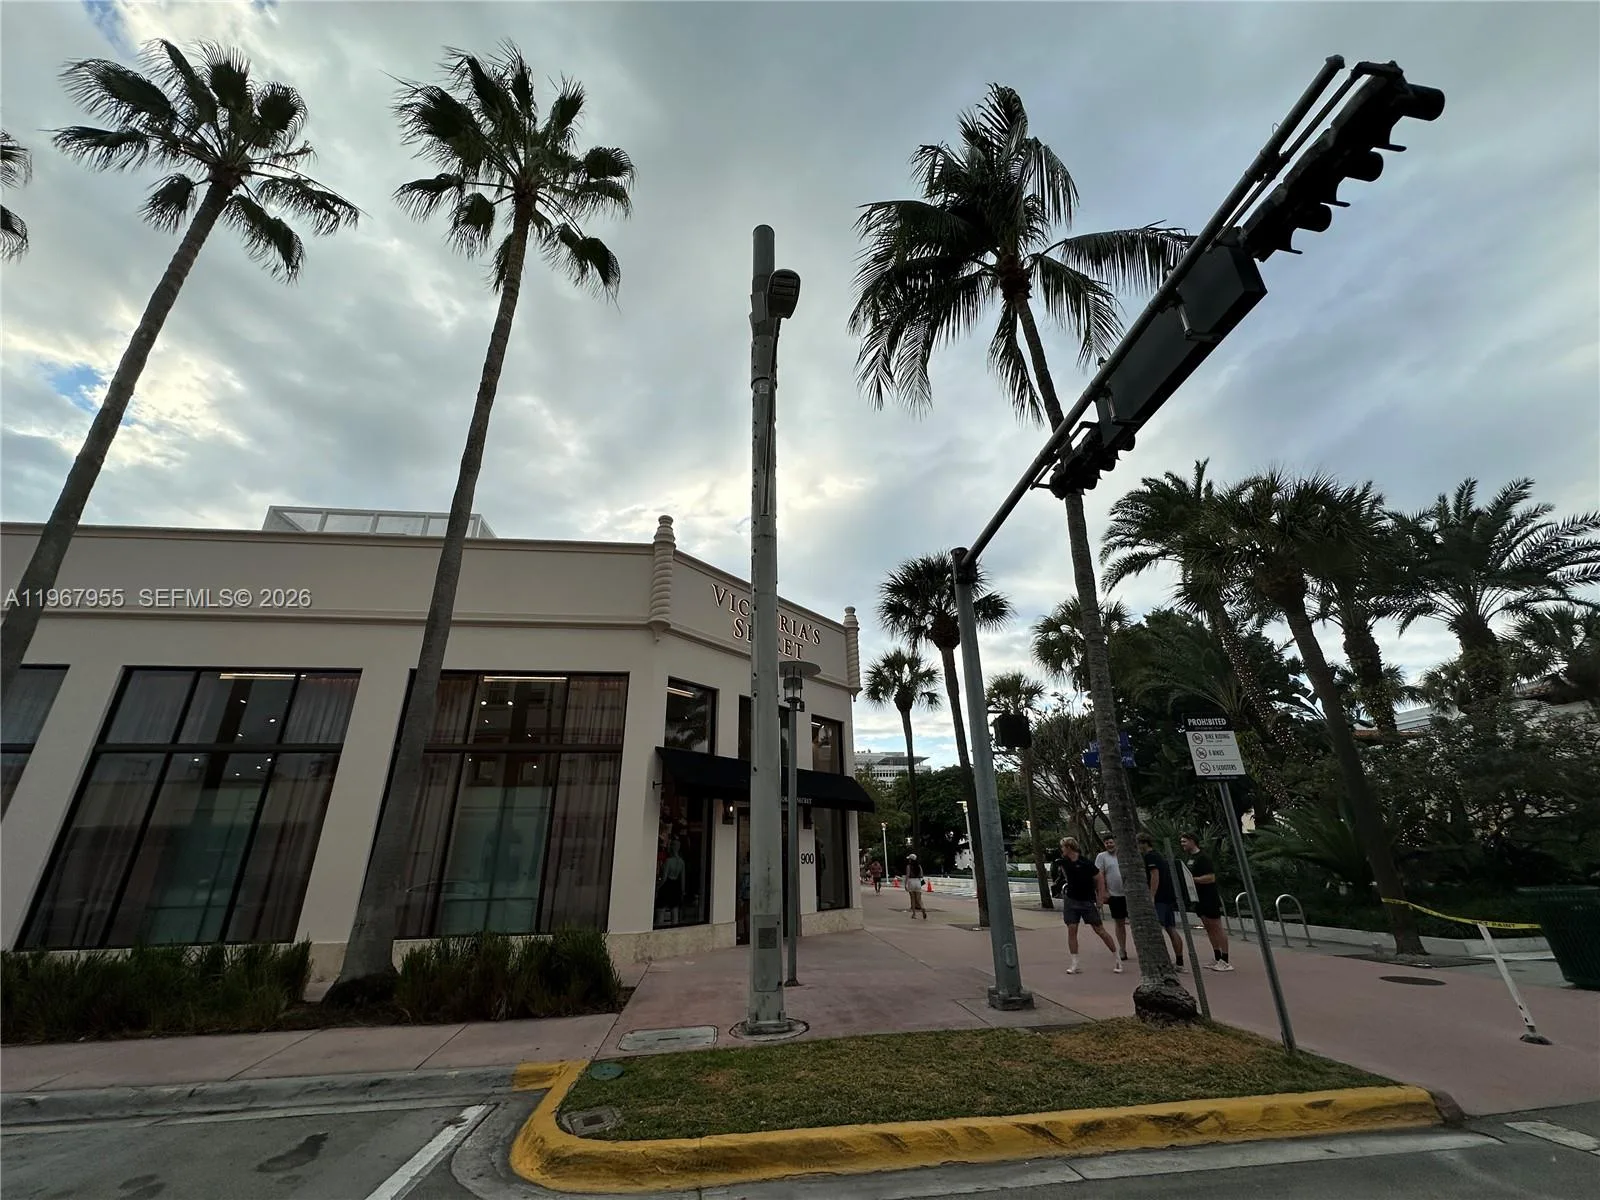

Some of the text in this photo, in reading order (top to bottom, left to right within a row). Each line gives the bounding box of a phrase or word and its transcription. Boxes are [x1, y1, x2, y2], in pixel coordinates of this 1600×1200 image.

[712, 583, 820, 646] VICRIA'S
[733, 617, 803, 660] SEET
[1187, 718, 1227, 726] PROHIBITED
[801, 853, 814, 865] 900
